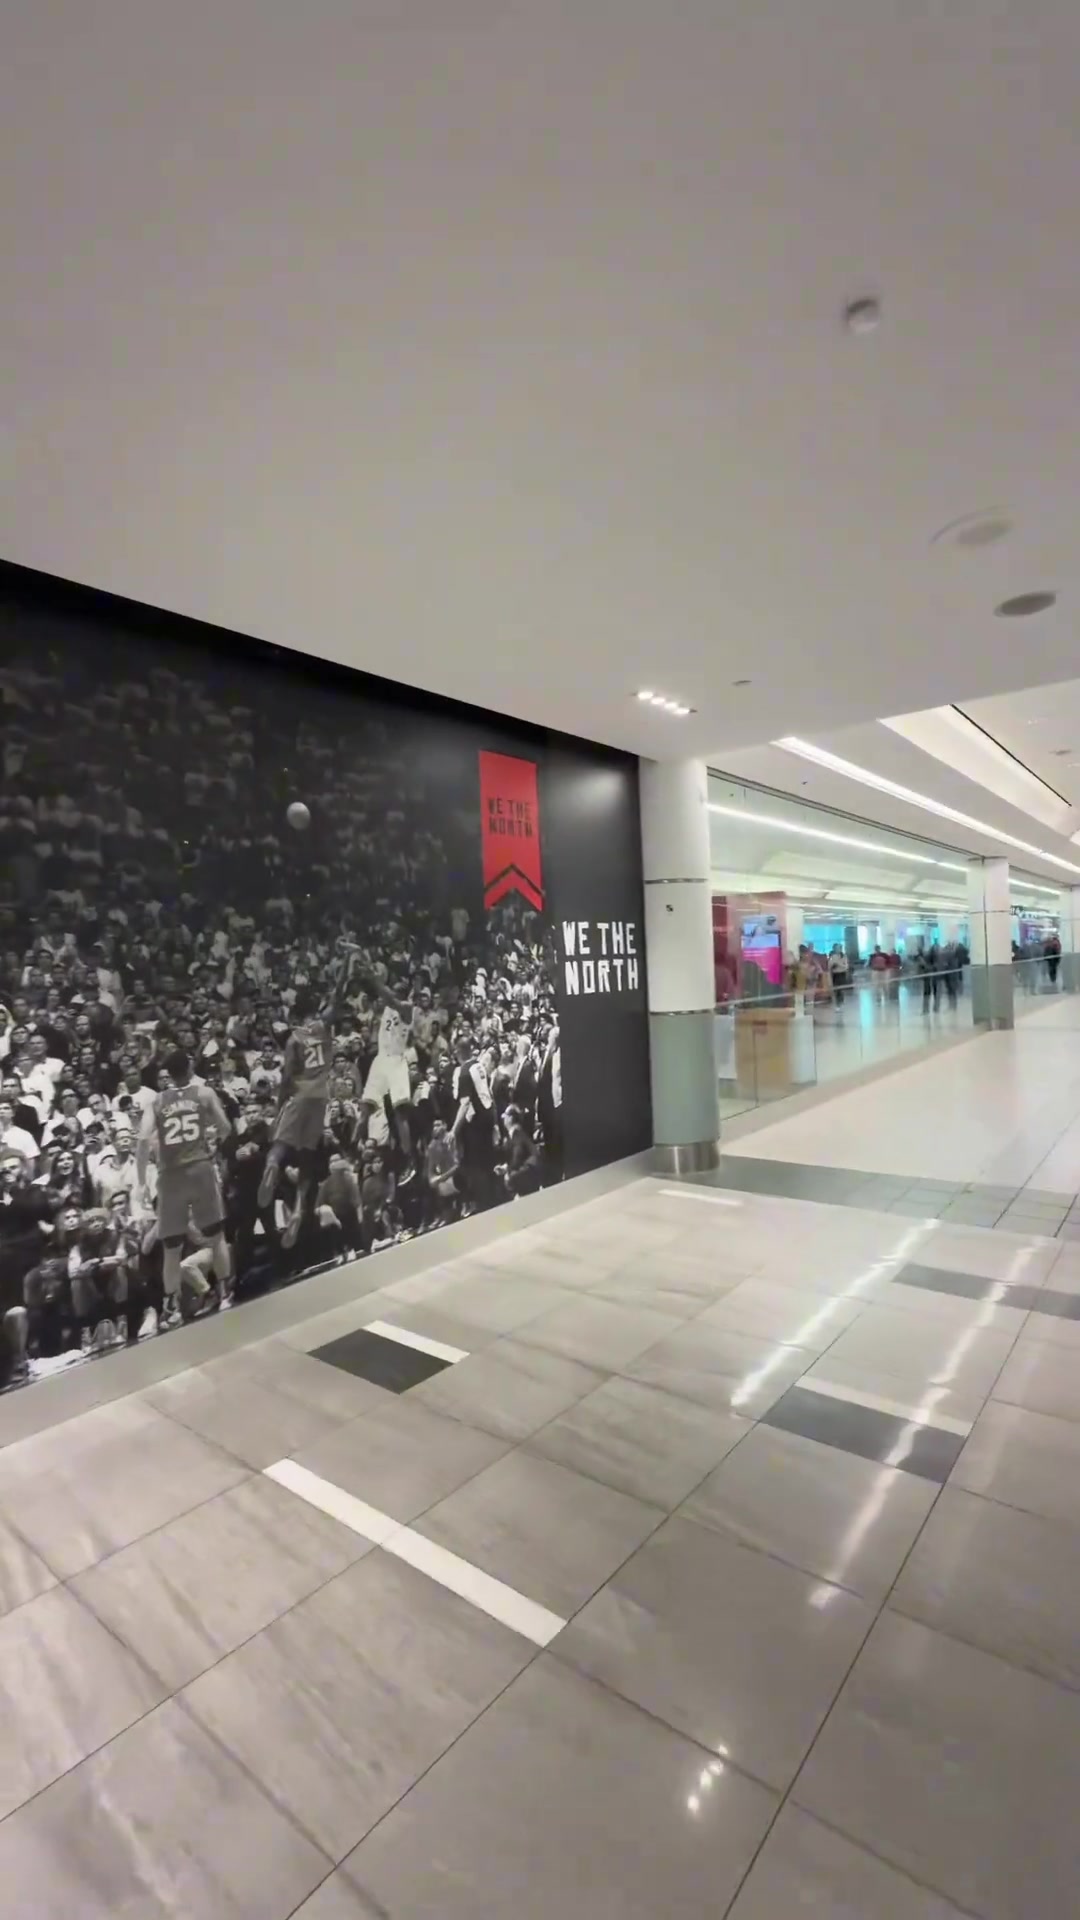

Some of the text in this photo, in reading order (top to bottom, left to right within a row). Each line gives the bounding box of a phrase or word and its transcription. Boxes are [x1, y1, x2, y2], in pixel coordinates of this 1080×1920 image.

[488, 797, 532, 820] WE THE
[489, 817, 533, 838] NORTH
[562, 920, 637, 957] WE THE
[565, 958, 639, 996] NORTH
[303, 1044, 326, 1069] 21
[163, 1113, 200, 1145] 25
